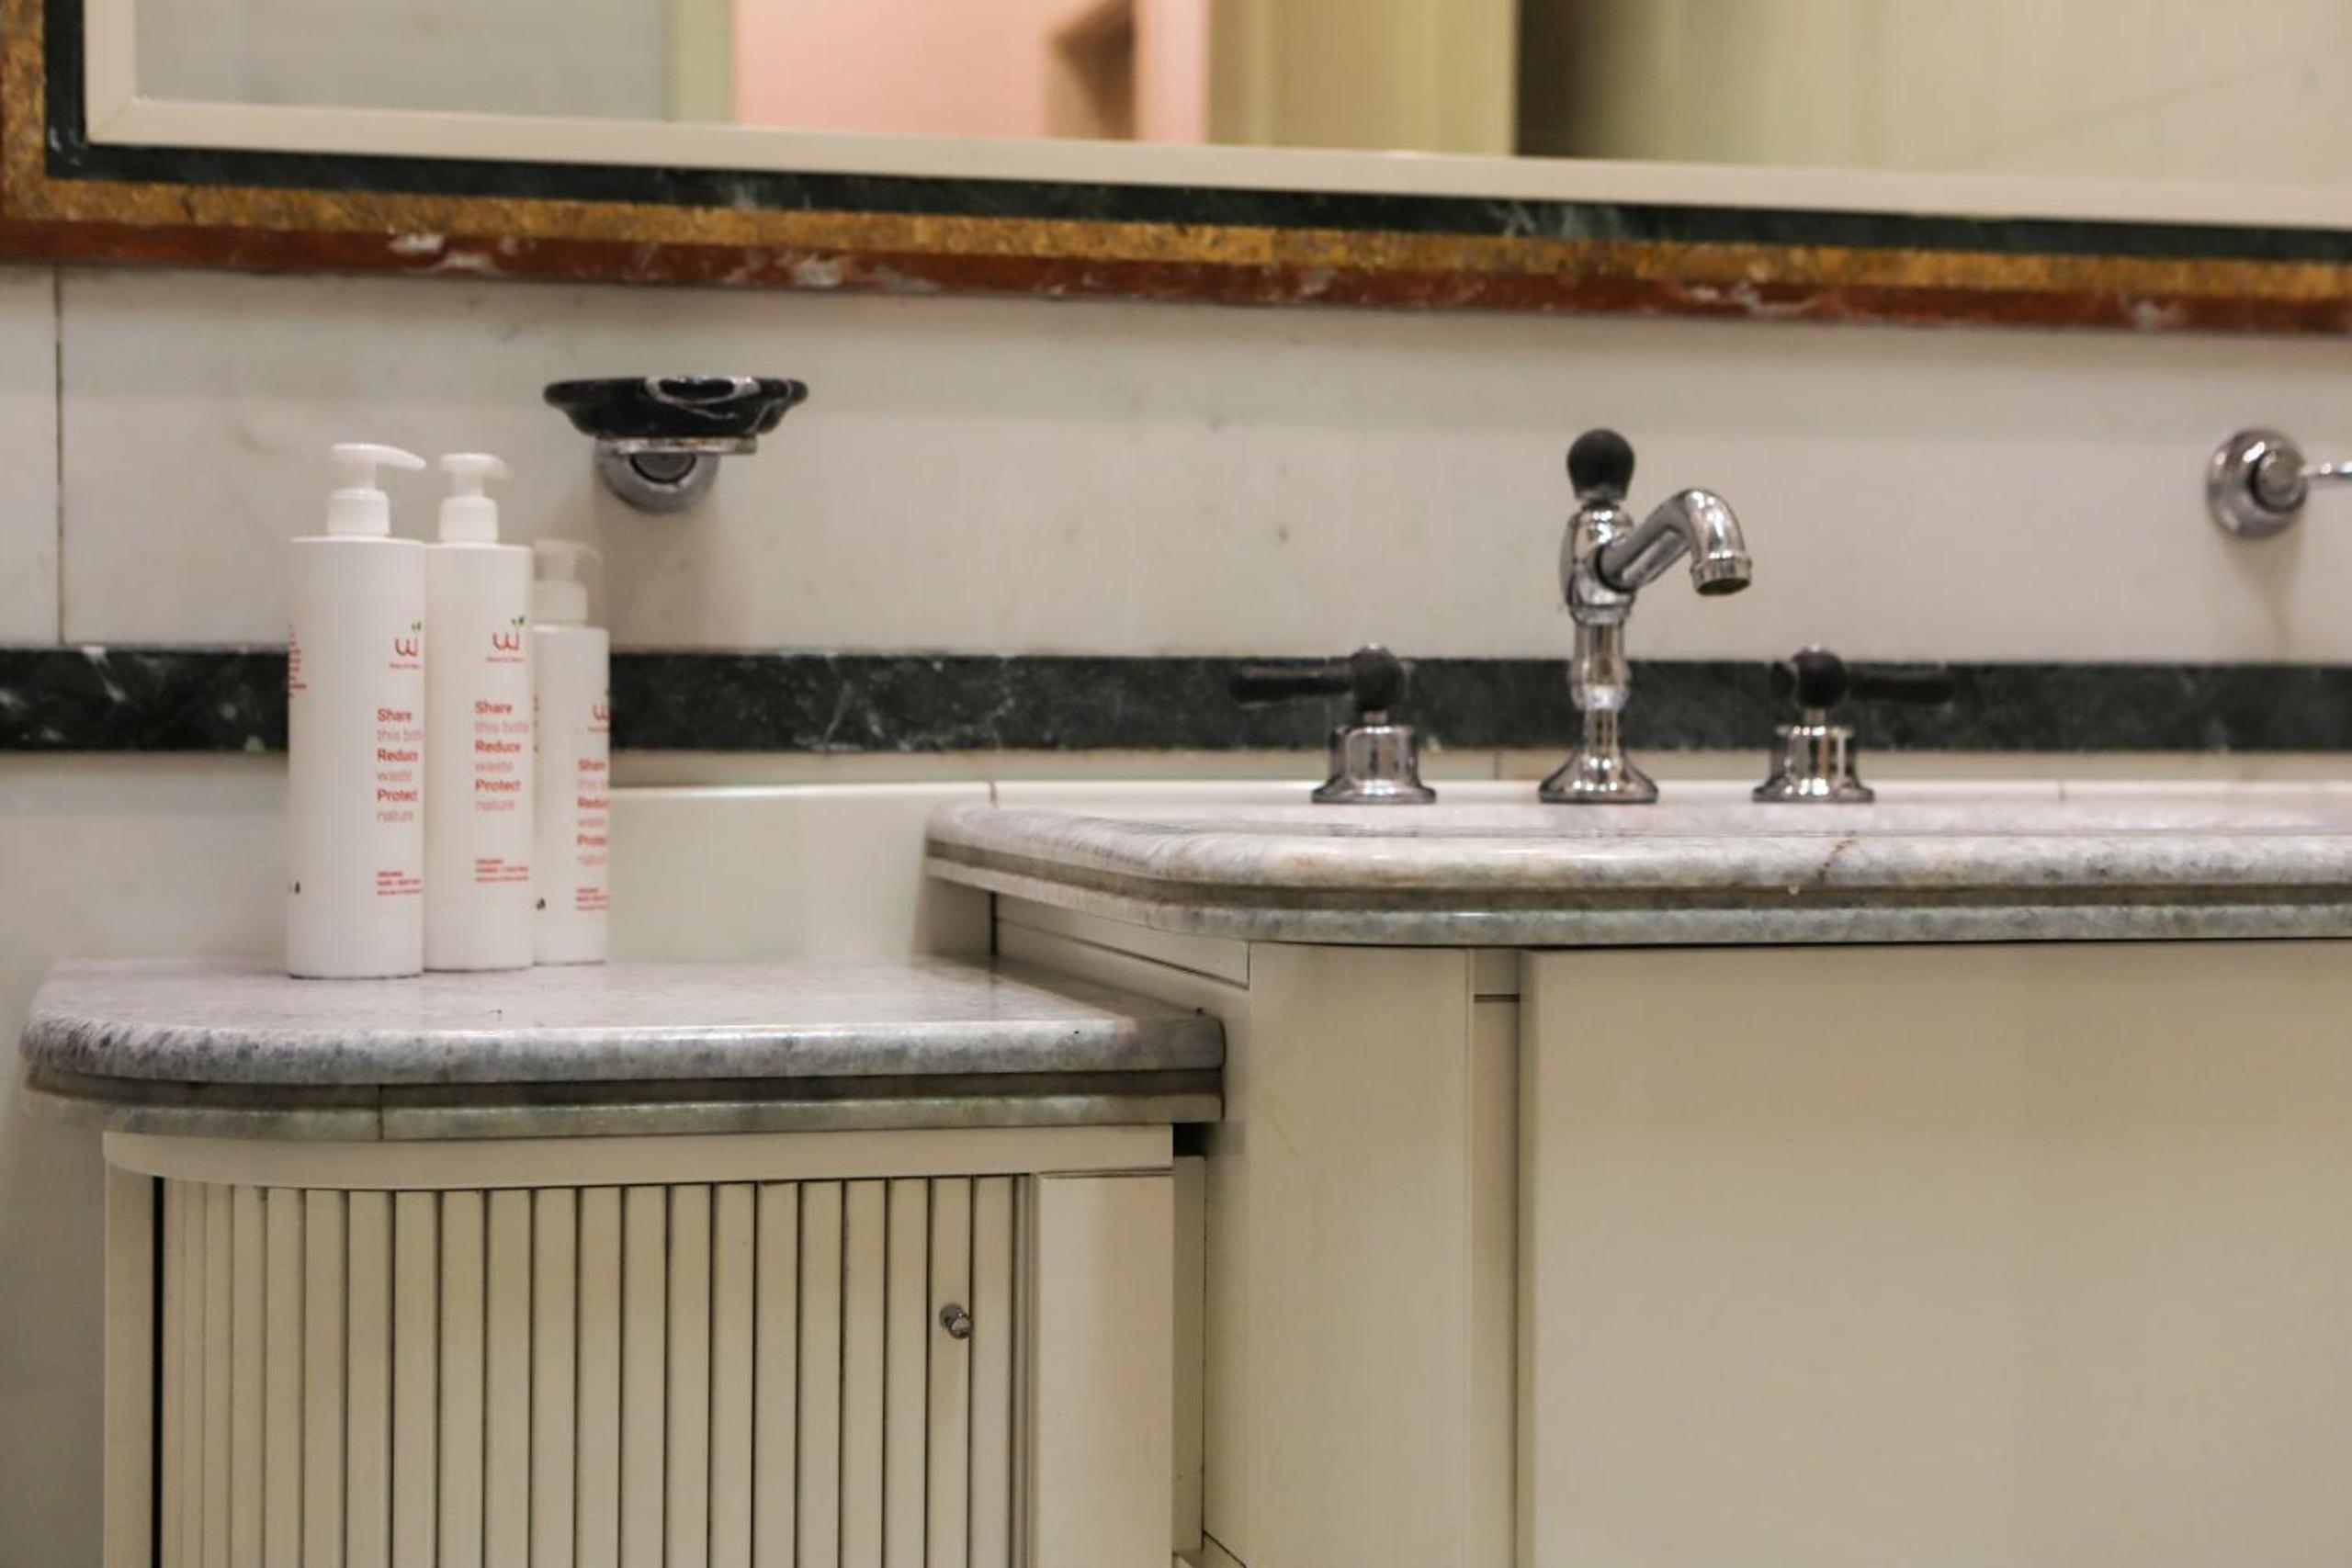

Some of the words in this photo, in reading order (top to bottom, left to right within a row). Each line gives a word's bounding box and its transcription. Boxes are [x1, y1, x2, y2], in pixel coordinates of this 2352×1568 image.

[475, 701, 513, 714] Share
[475, 739, 521, 752] Reduce
[475, 778, 521, 791] Protect
